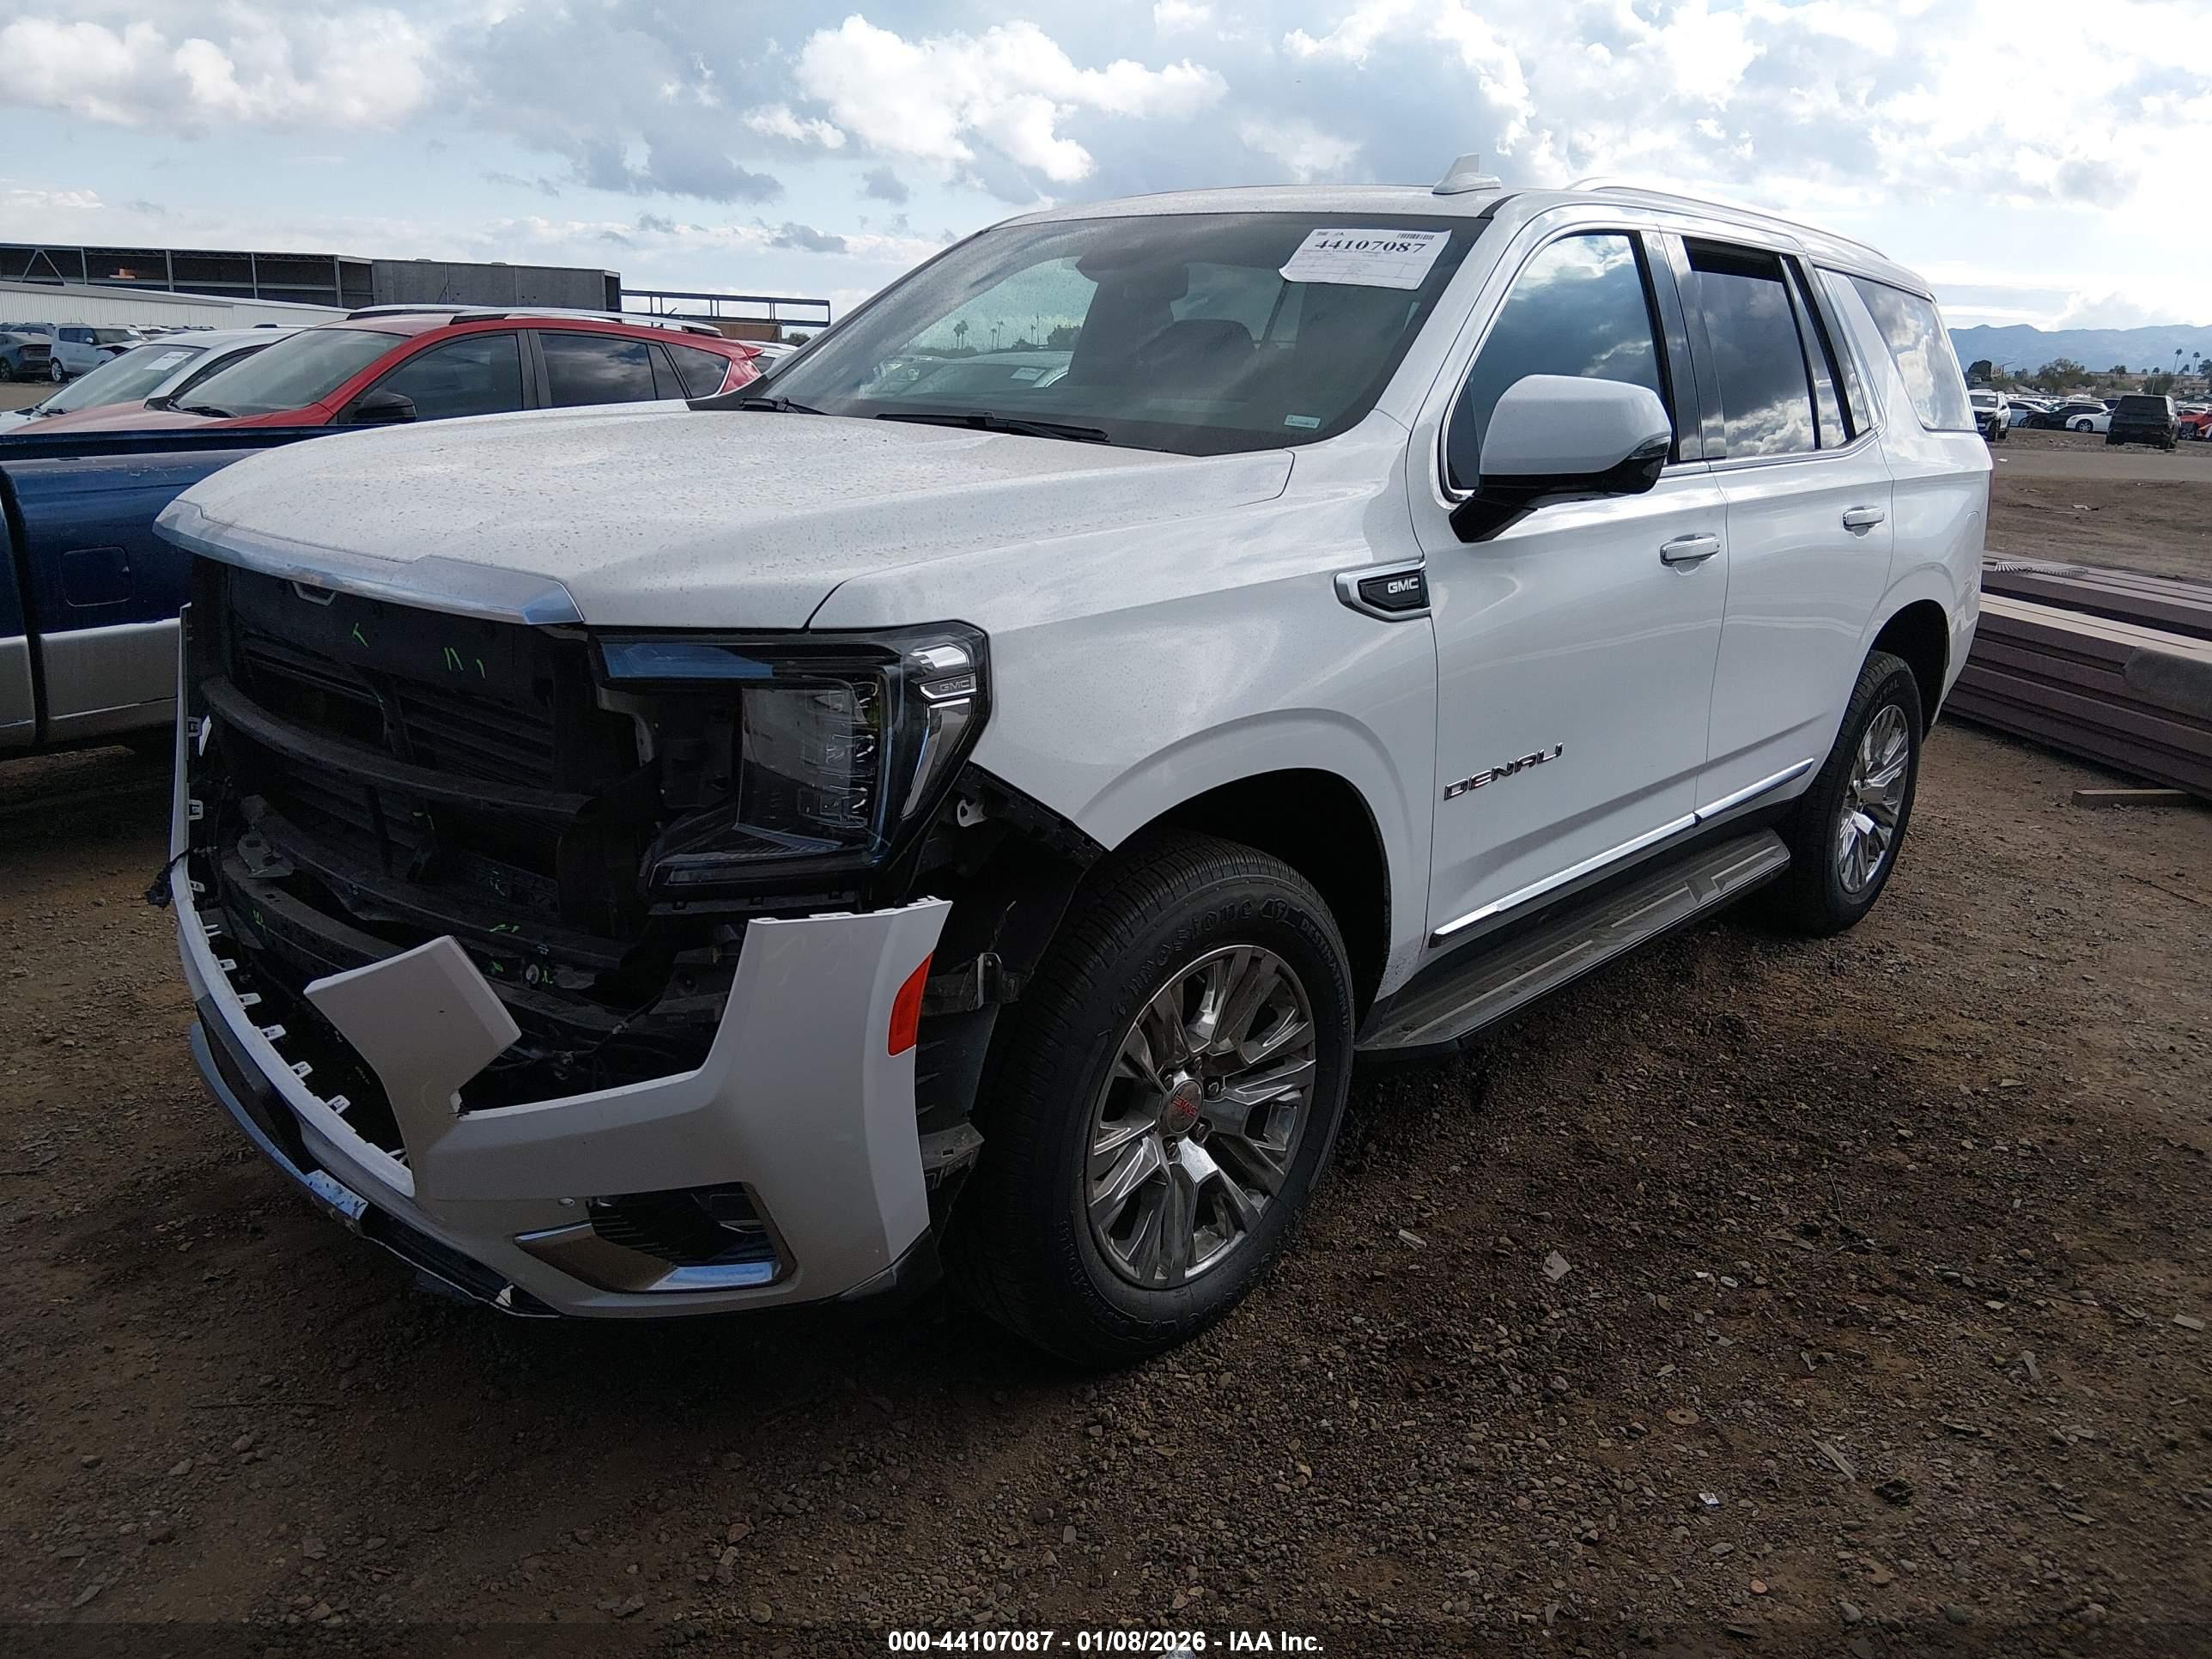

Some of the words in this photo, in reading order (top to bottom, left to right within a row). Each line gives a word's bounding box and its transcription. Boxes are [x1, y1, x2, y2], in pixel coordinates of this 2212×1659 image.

[1314, 239, 1427, 254] 44107087
[1387, 577, 1419, 594] GMC
[939, 679, 970, 691] GMC
[1443, 742, 1564, 800] DENALI
